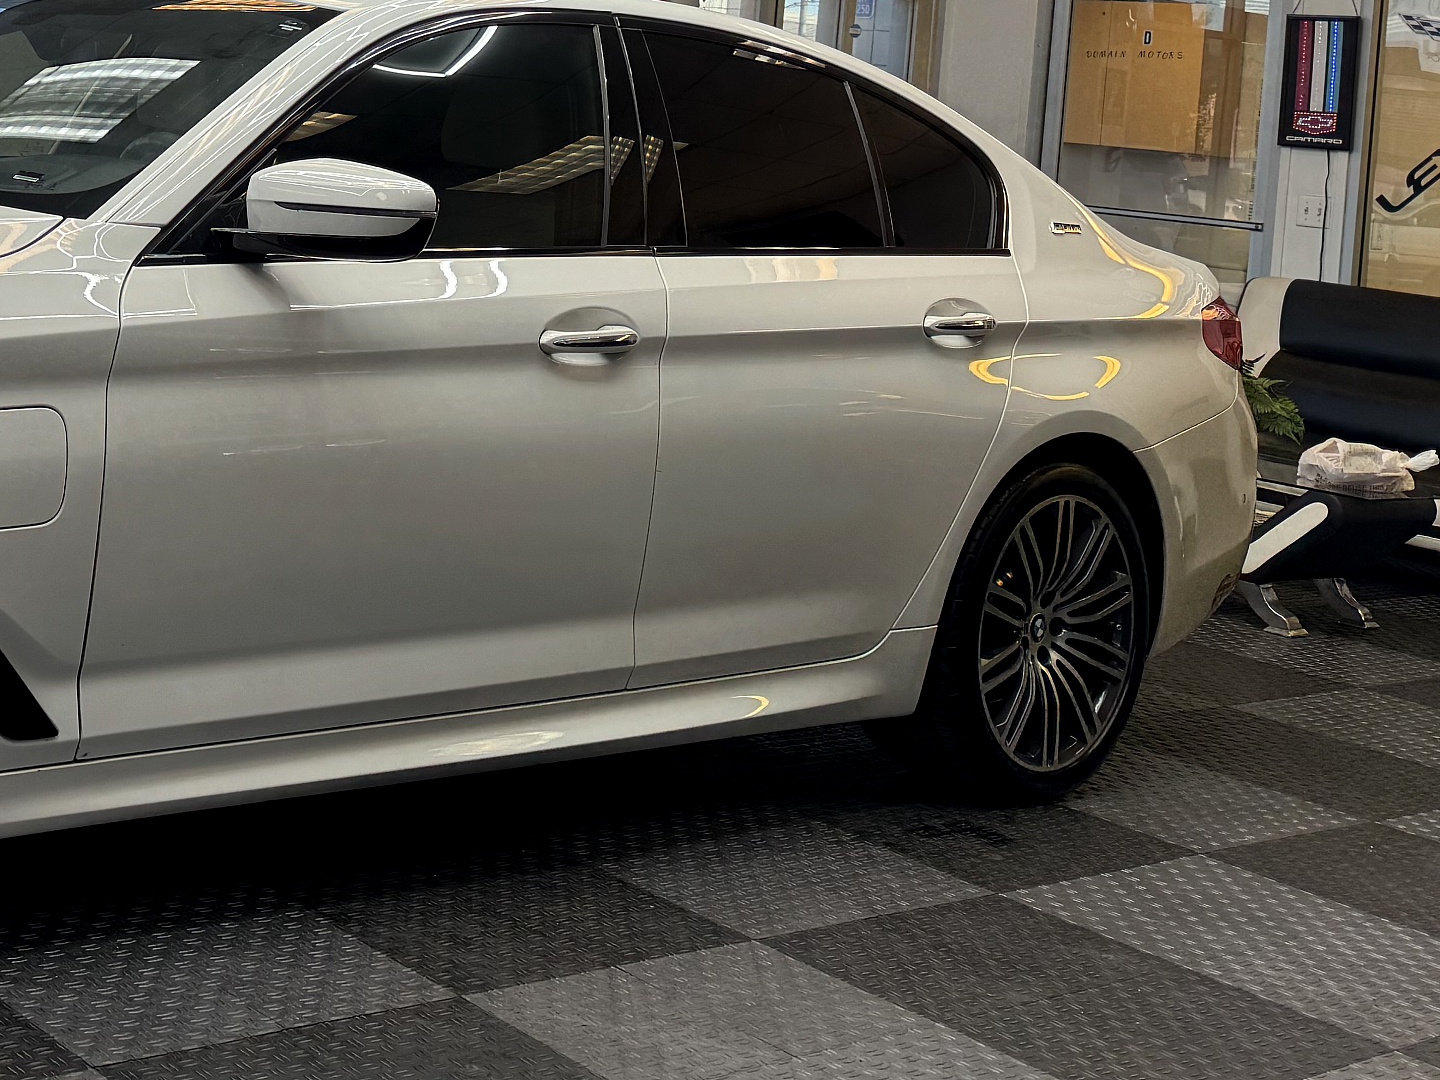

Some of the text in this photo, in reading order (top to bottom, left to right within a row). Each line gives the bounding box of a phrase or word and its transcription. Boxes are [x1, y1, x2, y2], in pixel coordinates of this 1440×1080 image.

[1143, 30, 1153, 45] D
[1086, 50, 1183, 60] DOMAIN MOTORS
[1285, 135, 1343, 145] CAMARO
